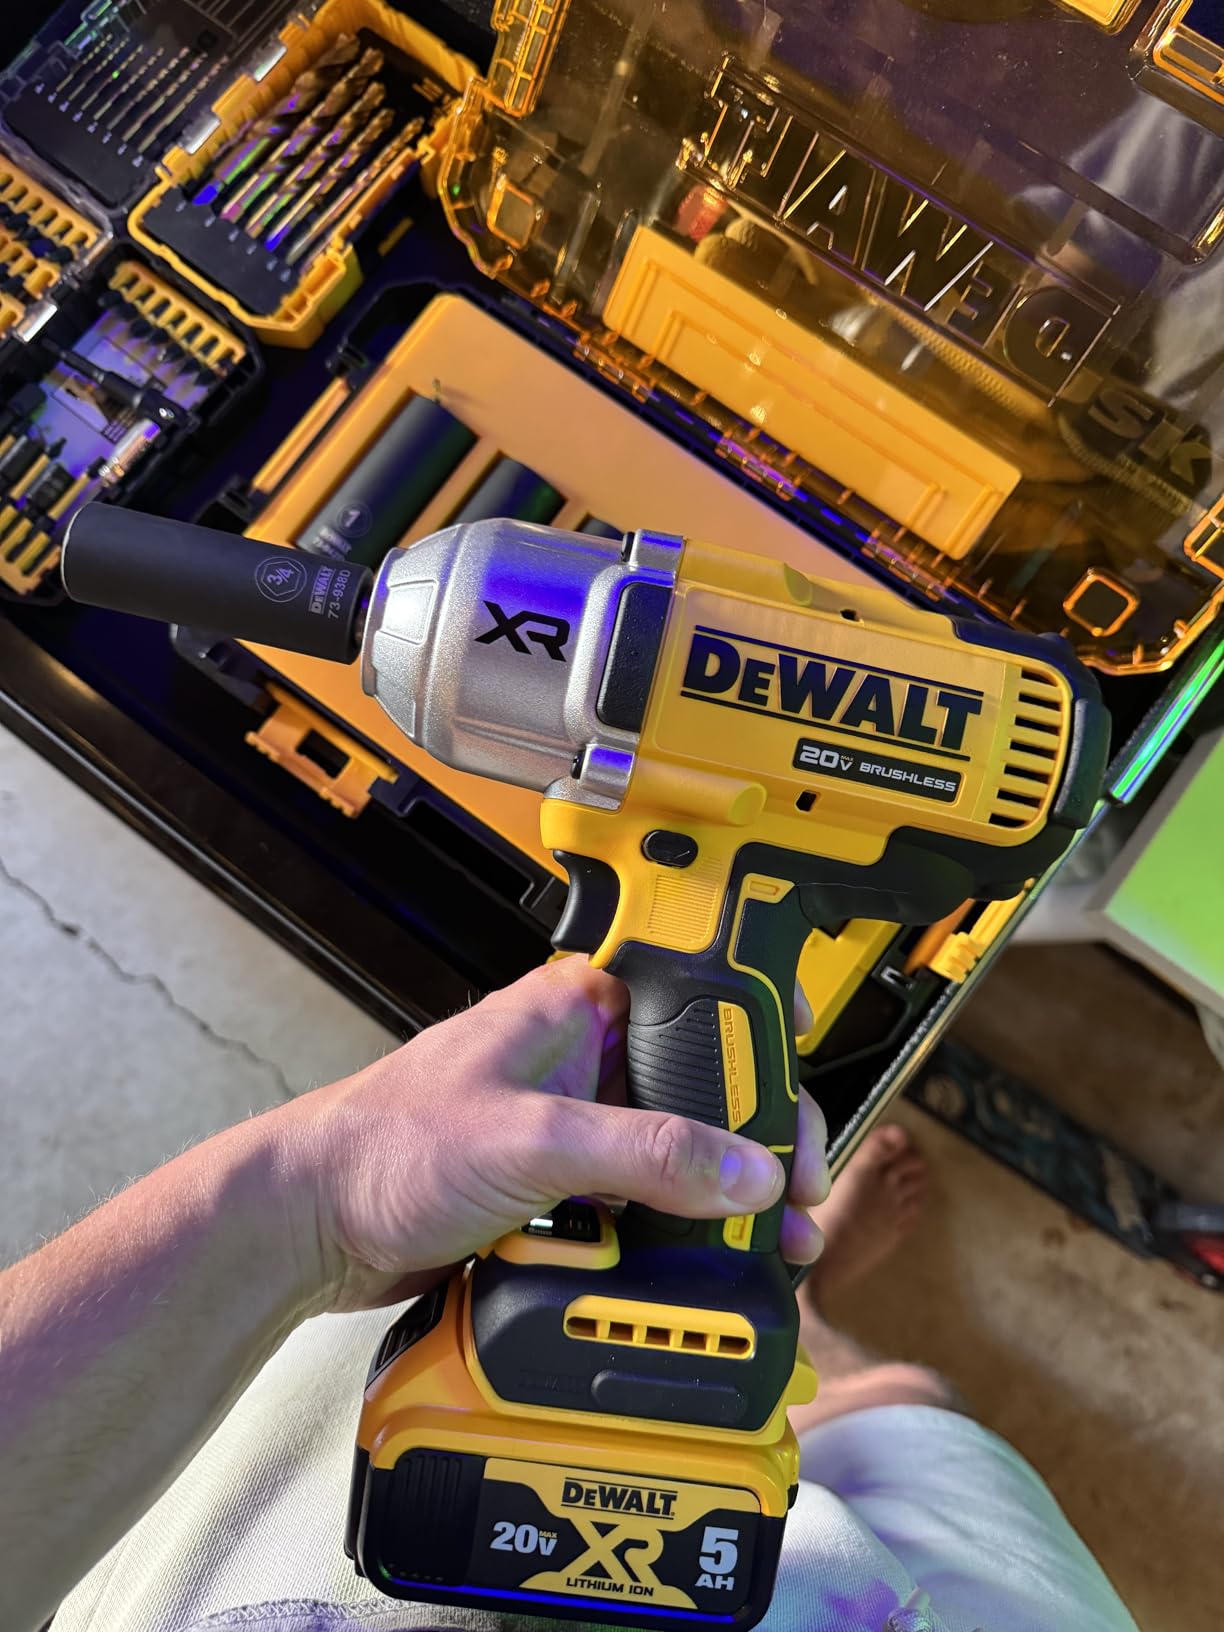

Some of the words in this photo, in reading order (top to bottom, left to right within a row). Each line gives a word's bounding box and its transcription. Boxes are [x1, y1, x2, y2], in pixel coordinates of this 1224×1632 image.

[266, 566, 295, 586] 3/4
[310, 564, 335, 615] DEWALT
[473, 599, 571, 663] XR
[682, 631, 984, 753] DEWALT
[799, 744, 853, 772] 20V
[858, 761, 958, 793] BRUSHLESS
[723, 1007, 742, 1124] BRUSHLESS
[560, 1481, 678, 1517] DEWALT
[489, 1520, 560, 1557] 20V
[559, 1518, 665, 1586] XR
[698, 1525, 740, 1575] 5
[565, 1576, 625, 1594] LITHIUM
[628, 1584, 655, 1597] ION
[694, 1574, 736, 1592] AH
